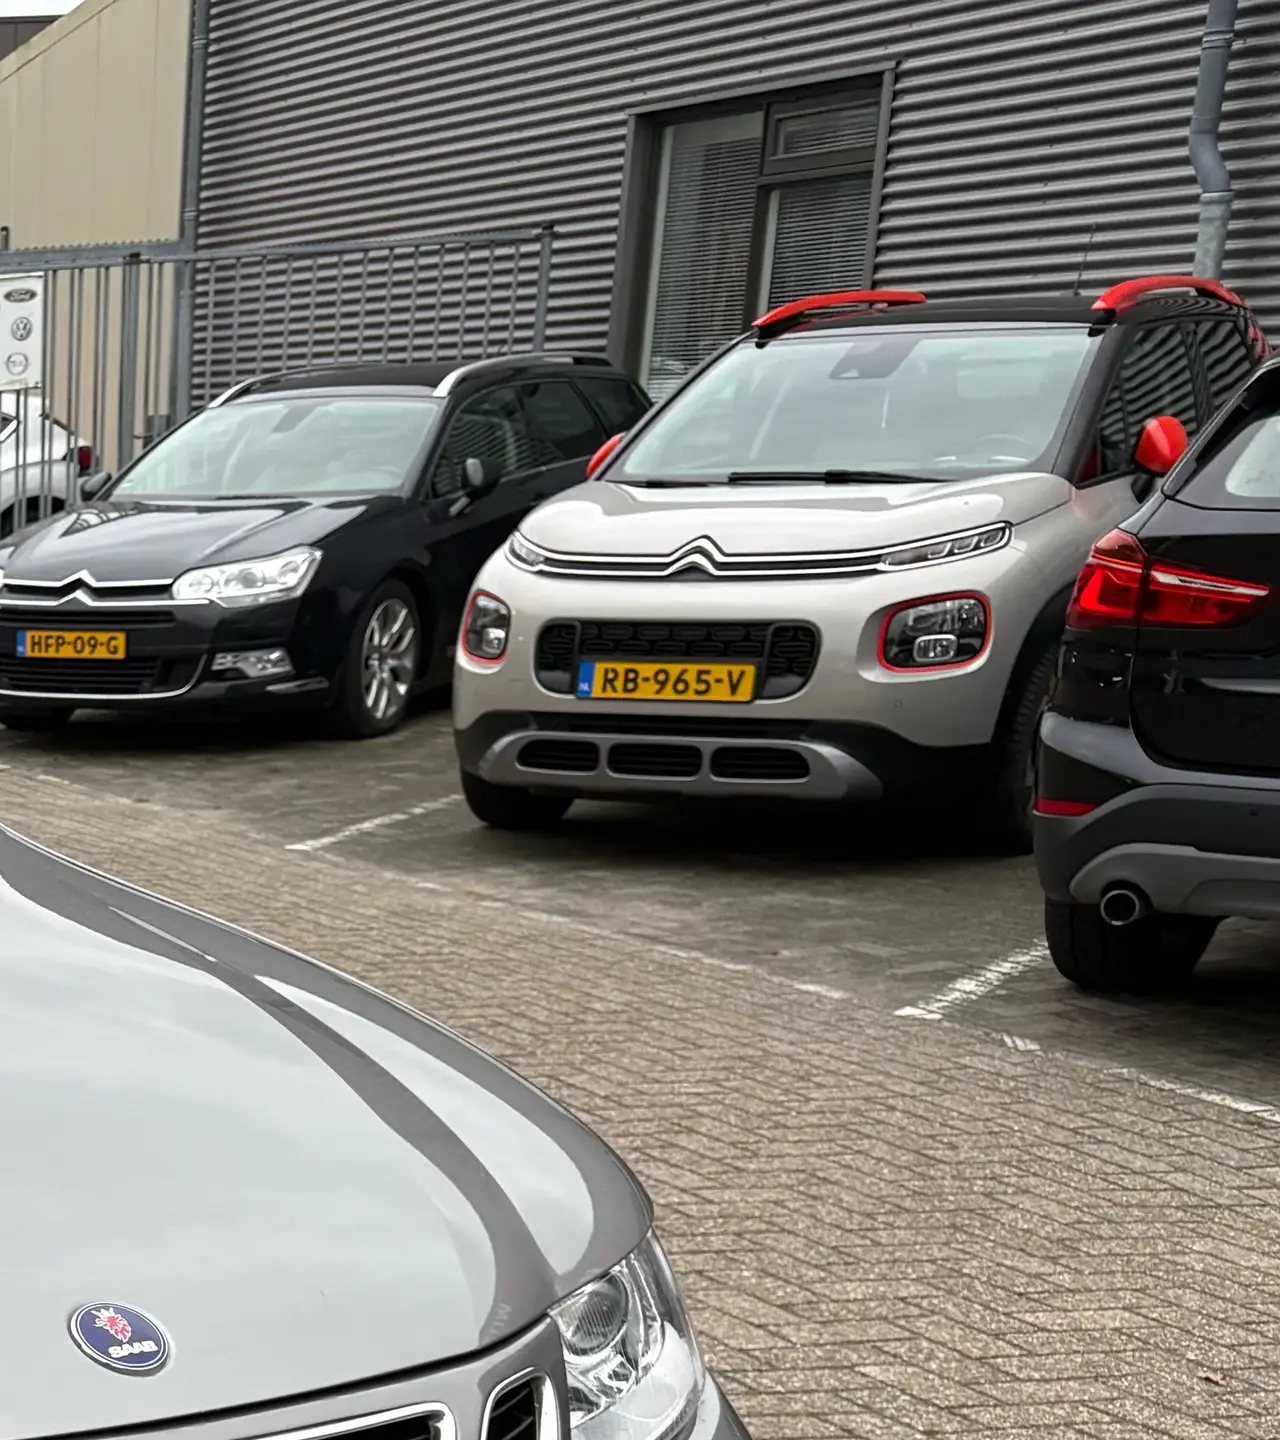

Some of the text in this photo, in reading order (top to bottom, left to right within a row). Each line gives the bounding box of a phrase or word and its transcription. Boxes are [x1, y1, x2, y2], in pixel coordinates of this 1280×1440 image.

[30, 634, 119, 656] HFP-09-G
[601, 667, 746, 696] RB-965-V
[108, 1340, 158, 1358] SAAB
